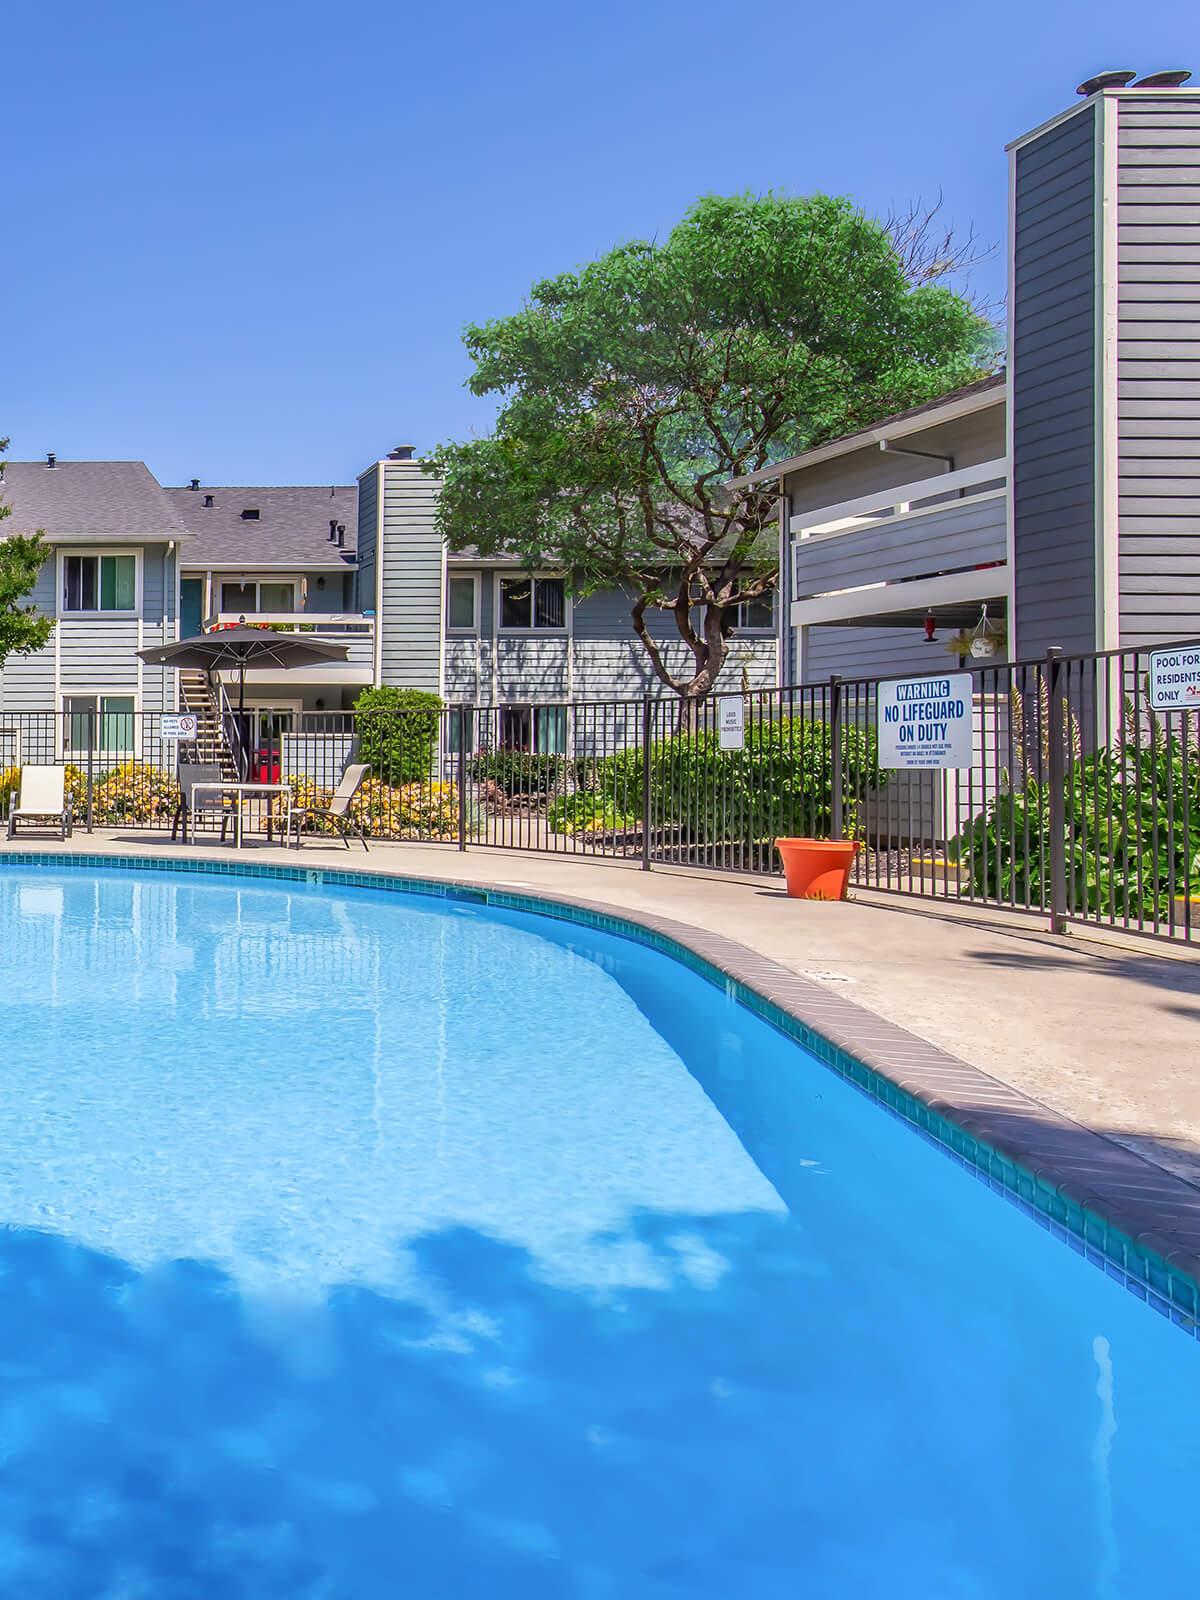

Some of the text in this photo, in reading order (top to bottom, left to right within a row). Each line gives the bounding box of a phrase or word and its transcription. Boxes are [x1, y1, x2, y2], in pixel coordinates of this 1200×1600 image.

[1156, 655, 1200, 668] POOL FOR
[897, 681, 948, 700] WARNING
[1157, 690, 1180, 701] ONLY
[885, 700, 964, 722] NO LIFEGUARD
[899, 723, 947, 742] ON DUTY
